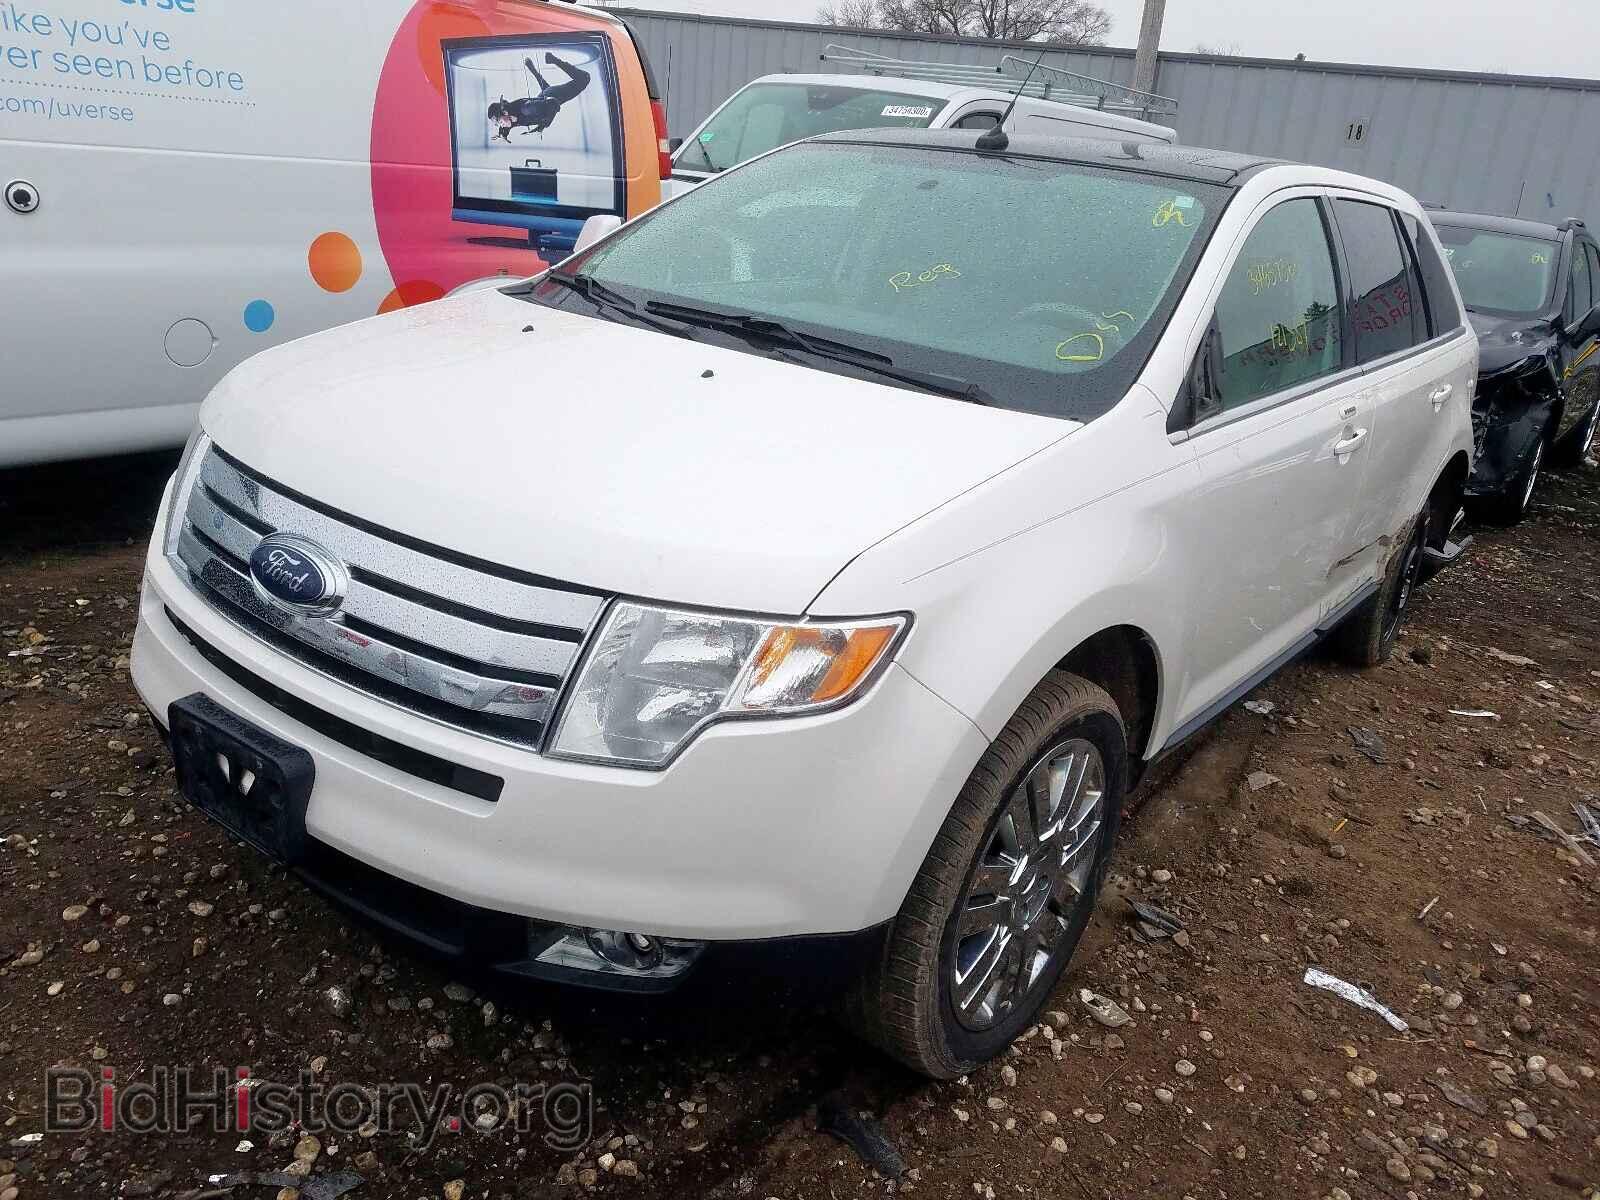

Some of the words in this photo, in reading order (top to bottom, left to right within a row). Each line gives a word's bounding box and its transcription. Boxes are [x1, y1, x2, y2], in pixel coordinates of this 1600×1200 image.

[60, 19, 170, 51] you've
[0, 45, 43, 70] er
[52, 50, 135, 80] seen
[142, 55, 244, 91] before
[1347, 123, 1364, 141] 18
[261, 549, 309, 593] Ford
